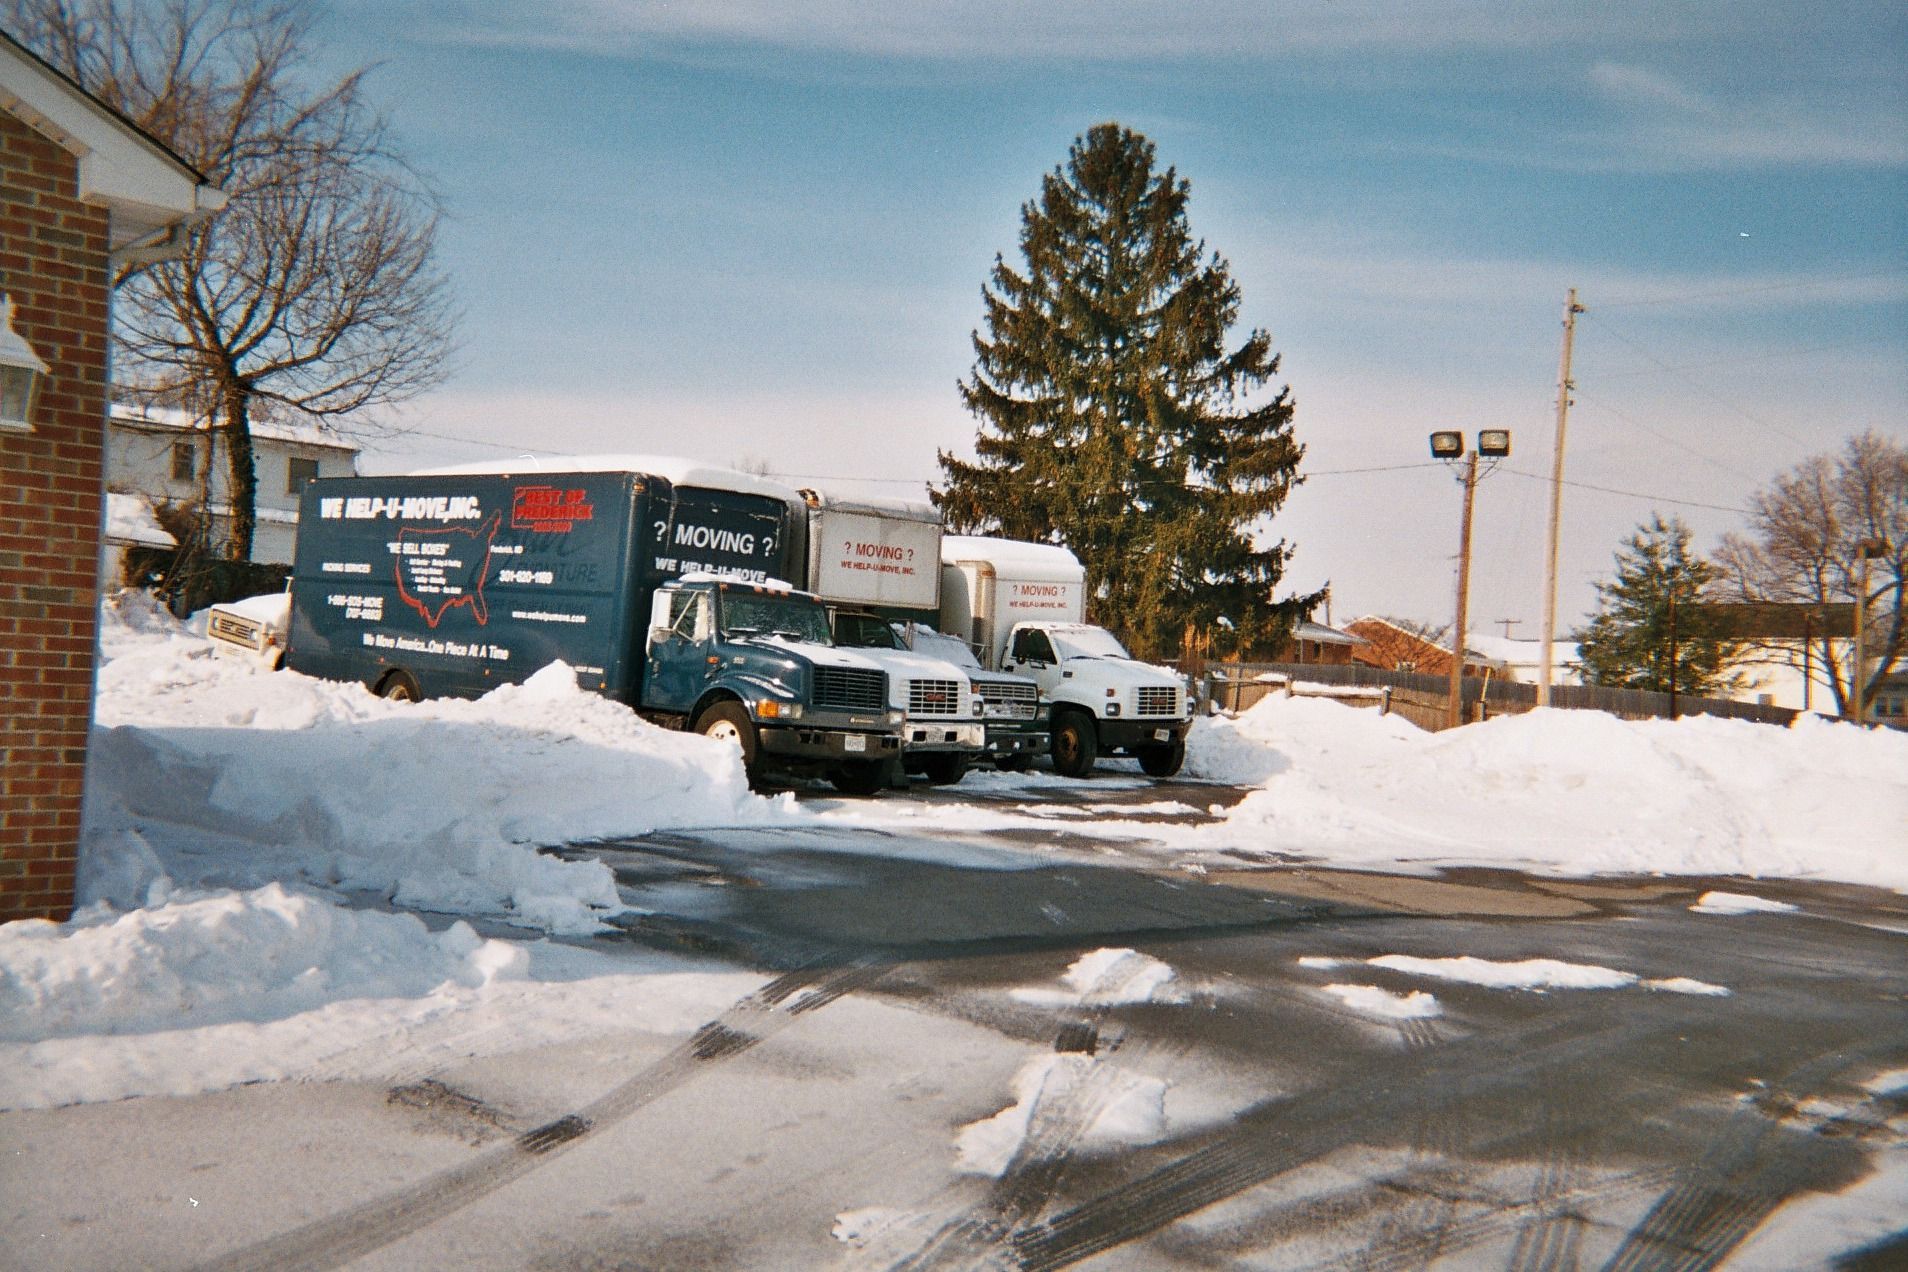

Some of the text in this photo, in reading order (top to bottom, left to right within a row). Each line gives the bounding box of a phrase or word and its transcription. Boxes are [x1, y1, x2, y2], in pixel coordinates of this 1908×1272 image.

[321, 498, 344, 518] WE
[654, 521, 773, 557] ? MOVING ?
[844, 541, 914, 561] ? MOVING ?
[655, 557, 677, 572] WE
[841, 560, 852, 568] WE
[1021, 585, 1058, 596] MOVING
[375, 634, 395, 648] Move
[479, 645, 487, 658] A
[488, 645, 510, 661] Time
